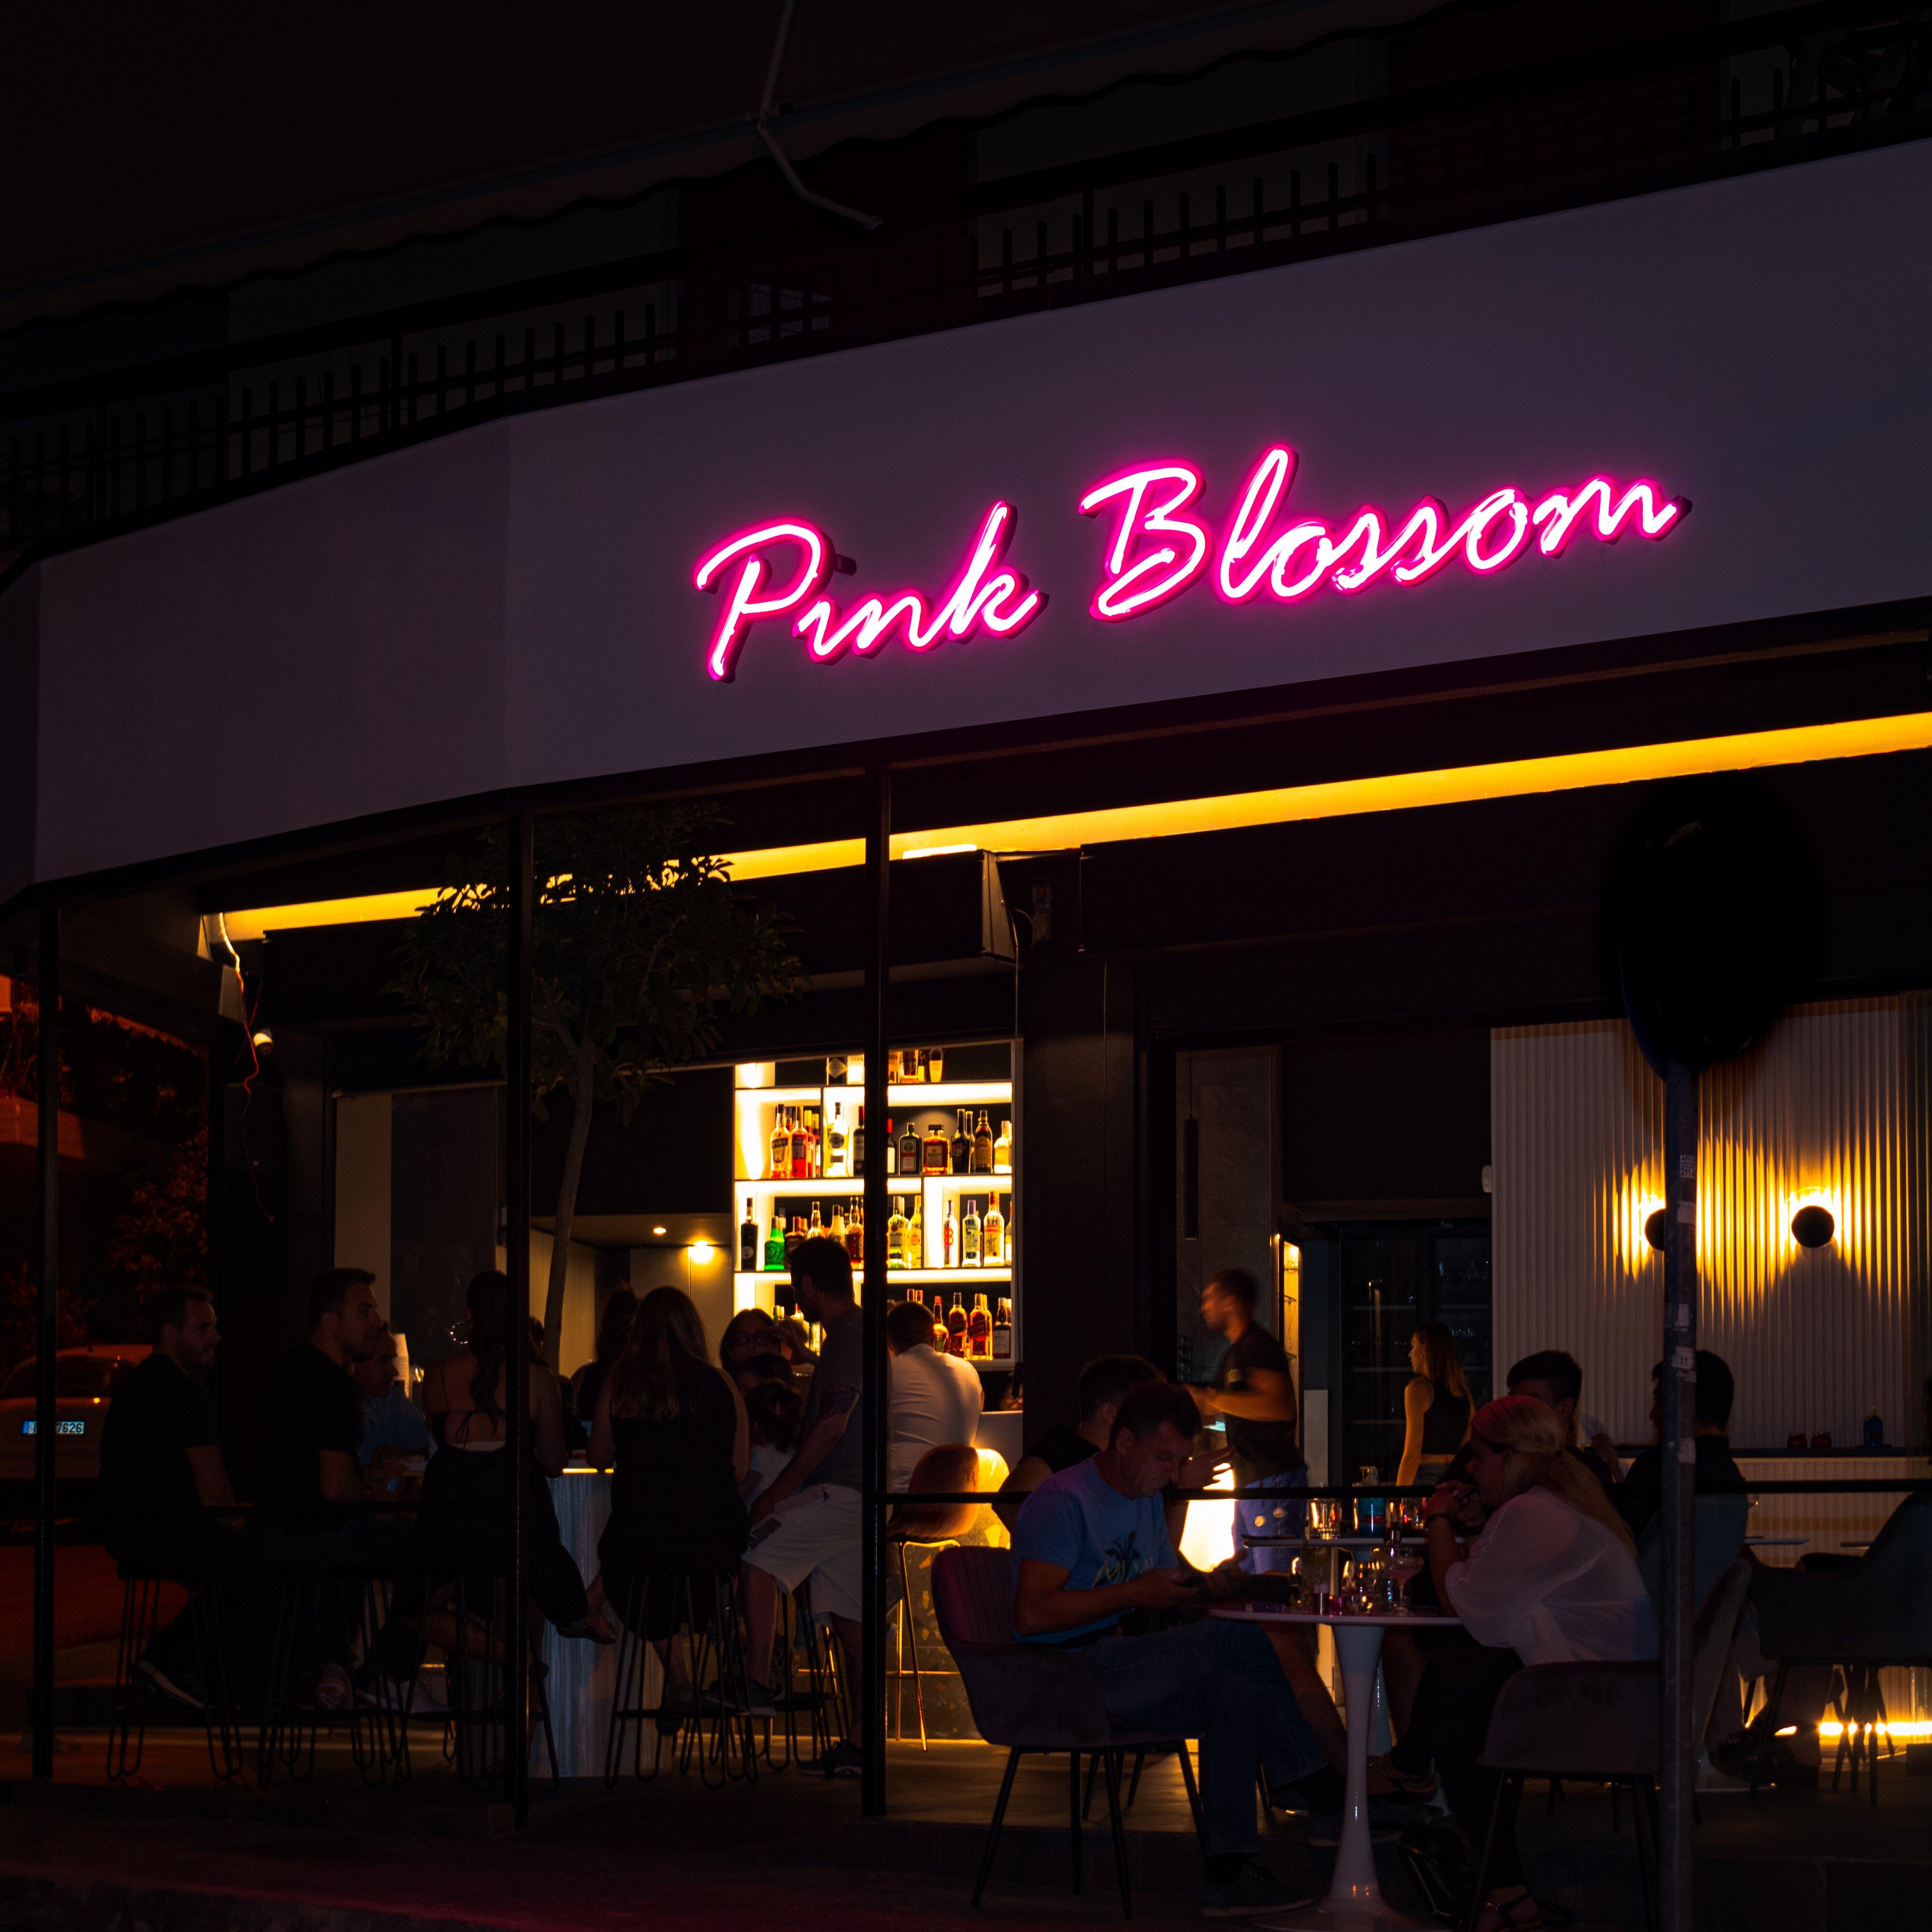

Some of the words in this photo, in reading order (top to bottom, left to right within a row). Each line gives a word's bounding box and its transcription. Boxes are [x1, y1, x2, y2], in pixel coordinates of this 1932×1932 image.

[693, 500, 1041, 680] Pink
[1079, 444, 1678, 620] Blossom
[57, 1423, 83, 1433] 7626
